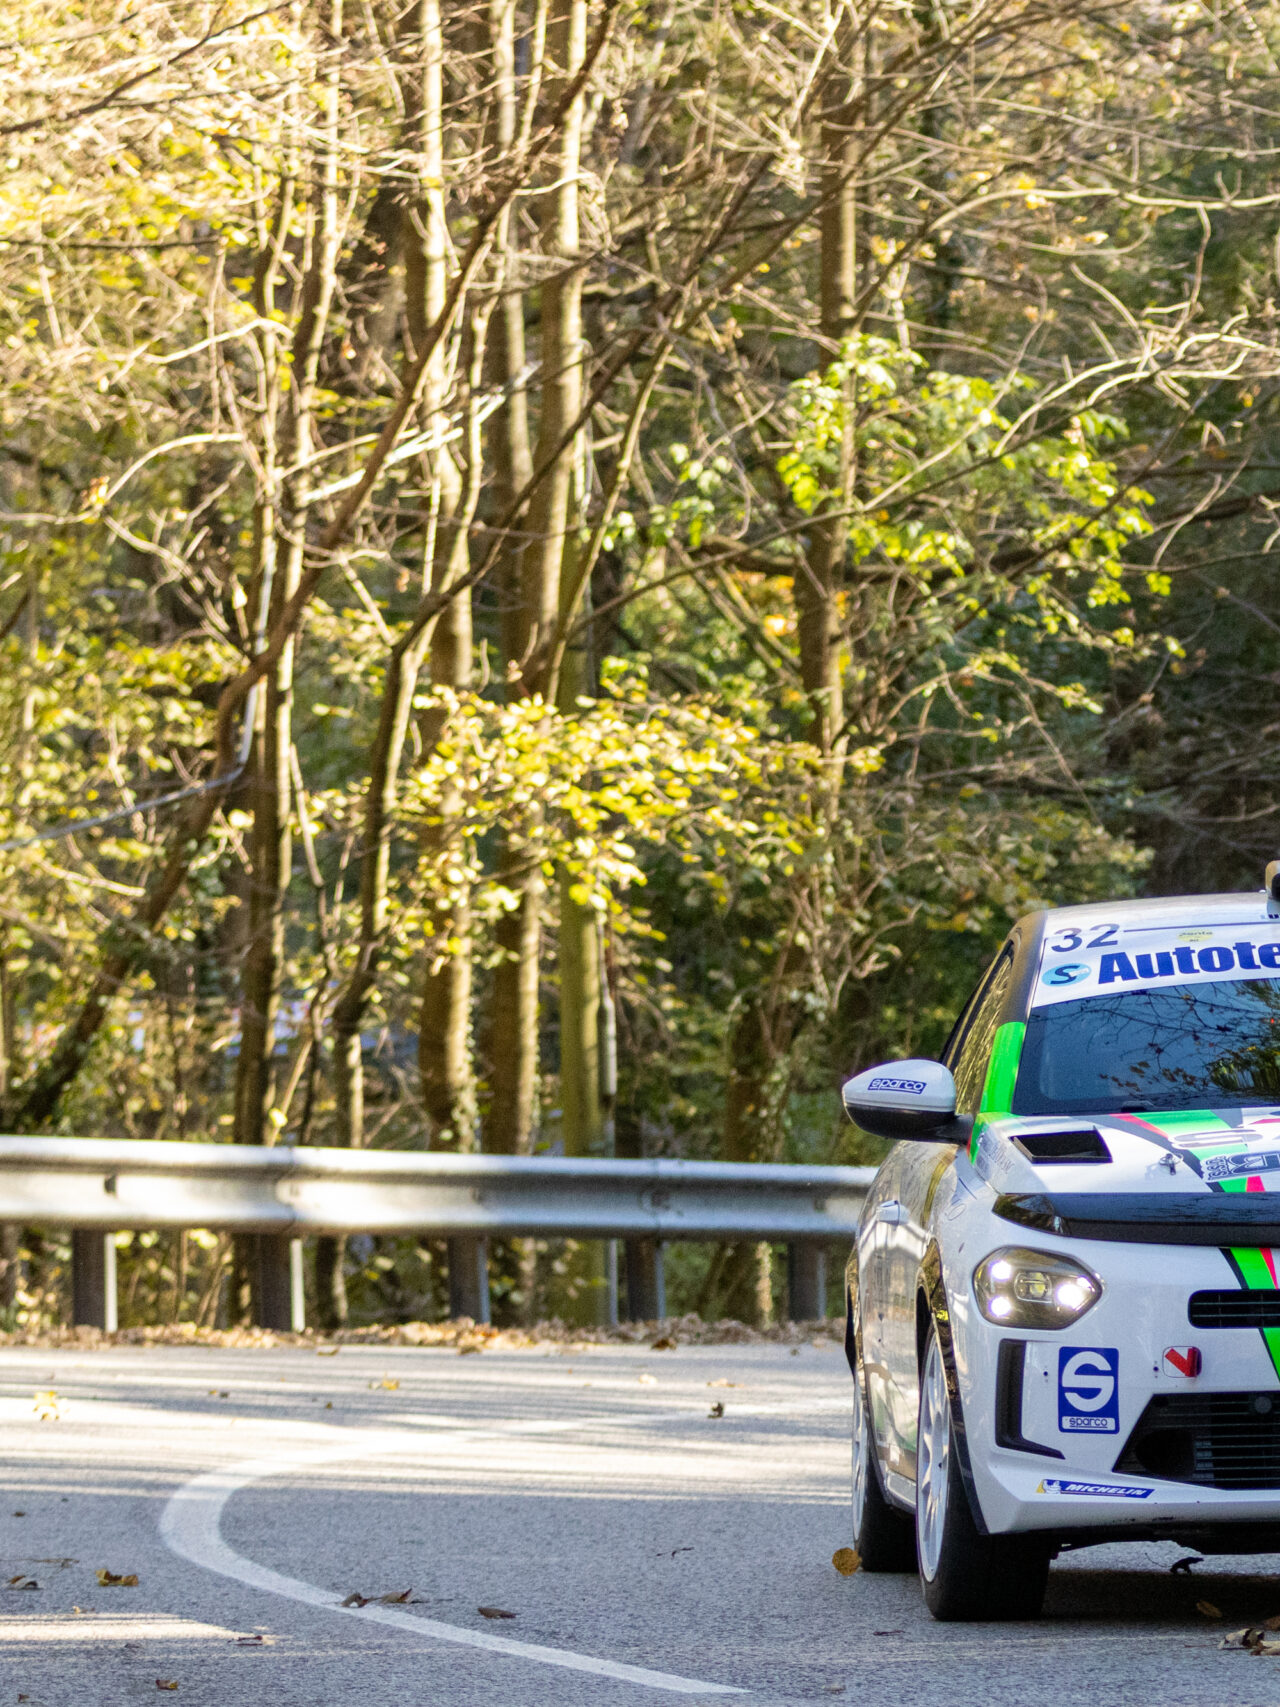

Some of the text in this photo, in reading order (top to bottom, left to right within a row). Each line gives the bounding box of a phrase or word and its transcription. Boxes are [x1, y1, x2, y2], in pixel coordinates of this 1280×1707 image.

[1051, 923, 1120, 953] 32
[871, 1079, 923, 1093] sparco
[1069, 1417, 1107, 1428] sparco
[1065, 1483, 1146, 1496] MICHELIN
